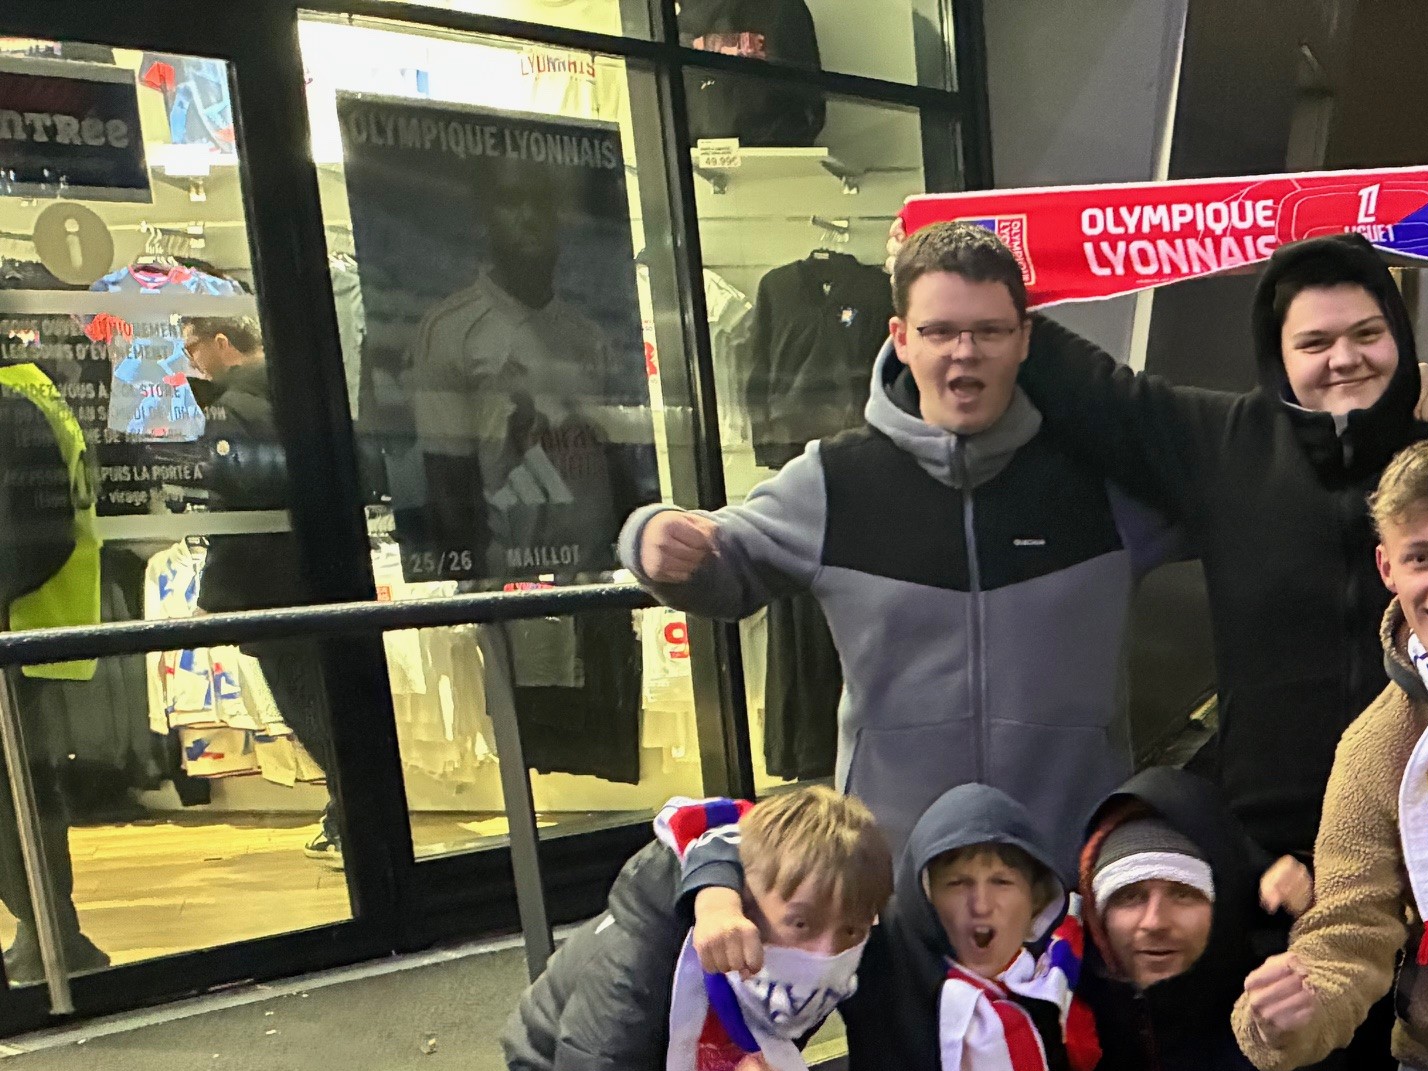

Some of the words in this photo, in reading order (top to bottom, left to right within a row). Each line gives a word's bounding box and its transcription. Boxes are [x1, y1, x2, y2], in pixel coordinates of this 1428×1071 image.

[350, 111, 500, 158] OLYMPIQUE
[504, 127, 619, 171] LYONNAIS
[1081, 199, 1276, 236] OLYMPIQUE
[1083, 234, 1278, 276] LYONNAIS
[133, 465, 150, 481] LA
[410, 550, 473, 575] 25/26
[506, 544, 579, 567] MAILLOT
